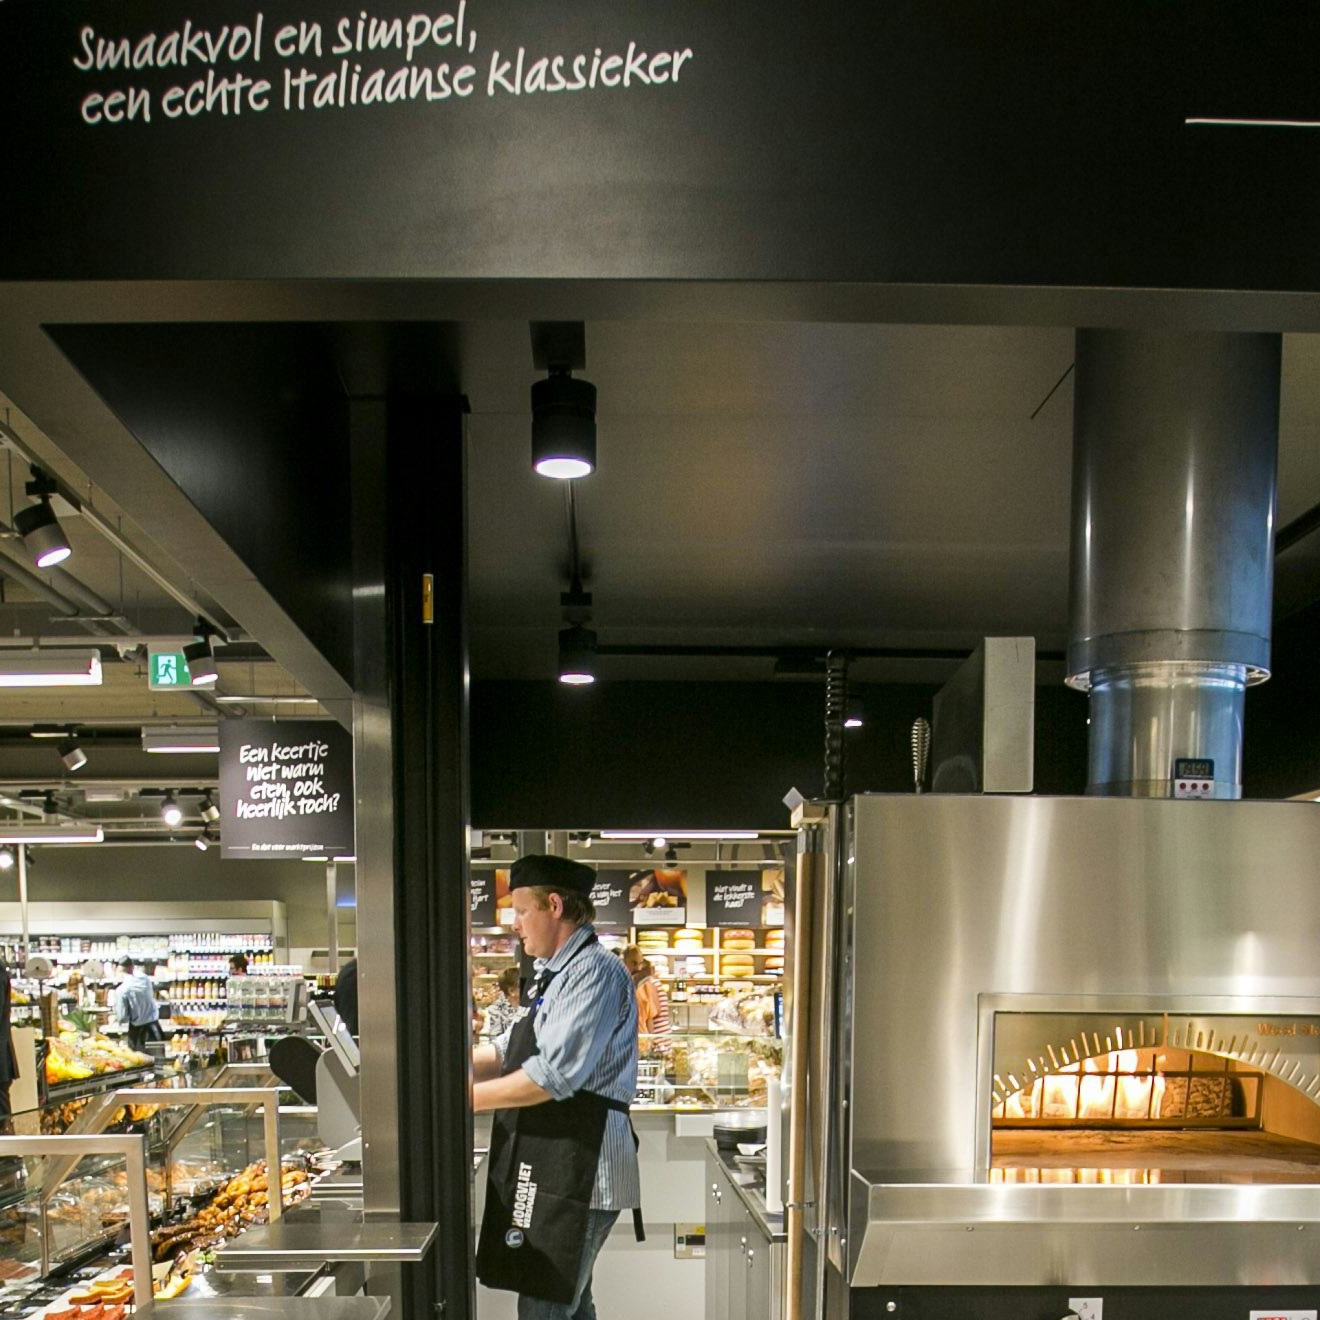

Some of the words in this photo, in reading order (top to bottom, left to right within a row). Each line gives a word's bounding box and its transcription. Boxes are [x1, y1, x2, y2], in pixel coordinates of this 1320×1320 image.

[72, 11, 264, 71] Smaakvol
[274, 20, 322, 57] en
[331, 0, 477, 62] simpel,
[80, 86, 151, 124] een
[161, 68, 272, 118] echte
[283, 59, 477, 110] Italiaanse
[487, 41, 693, 97] klassieker
[240, 744, 269, 764] Een
[271, 740, 329, 763] keertje
[246, 763, 281, 781] niet
[281, 763, 324, 780] warm
[250, 782, 291, 800] eten,
[293, 777, 325, 797] ook
[236, 797, 297, 820] heerlijk
[297, 793, 341, 815] toch?
[511, 1161, 533, 1228] HOOGVLIET
